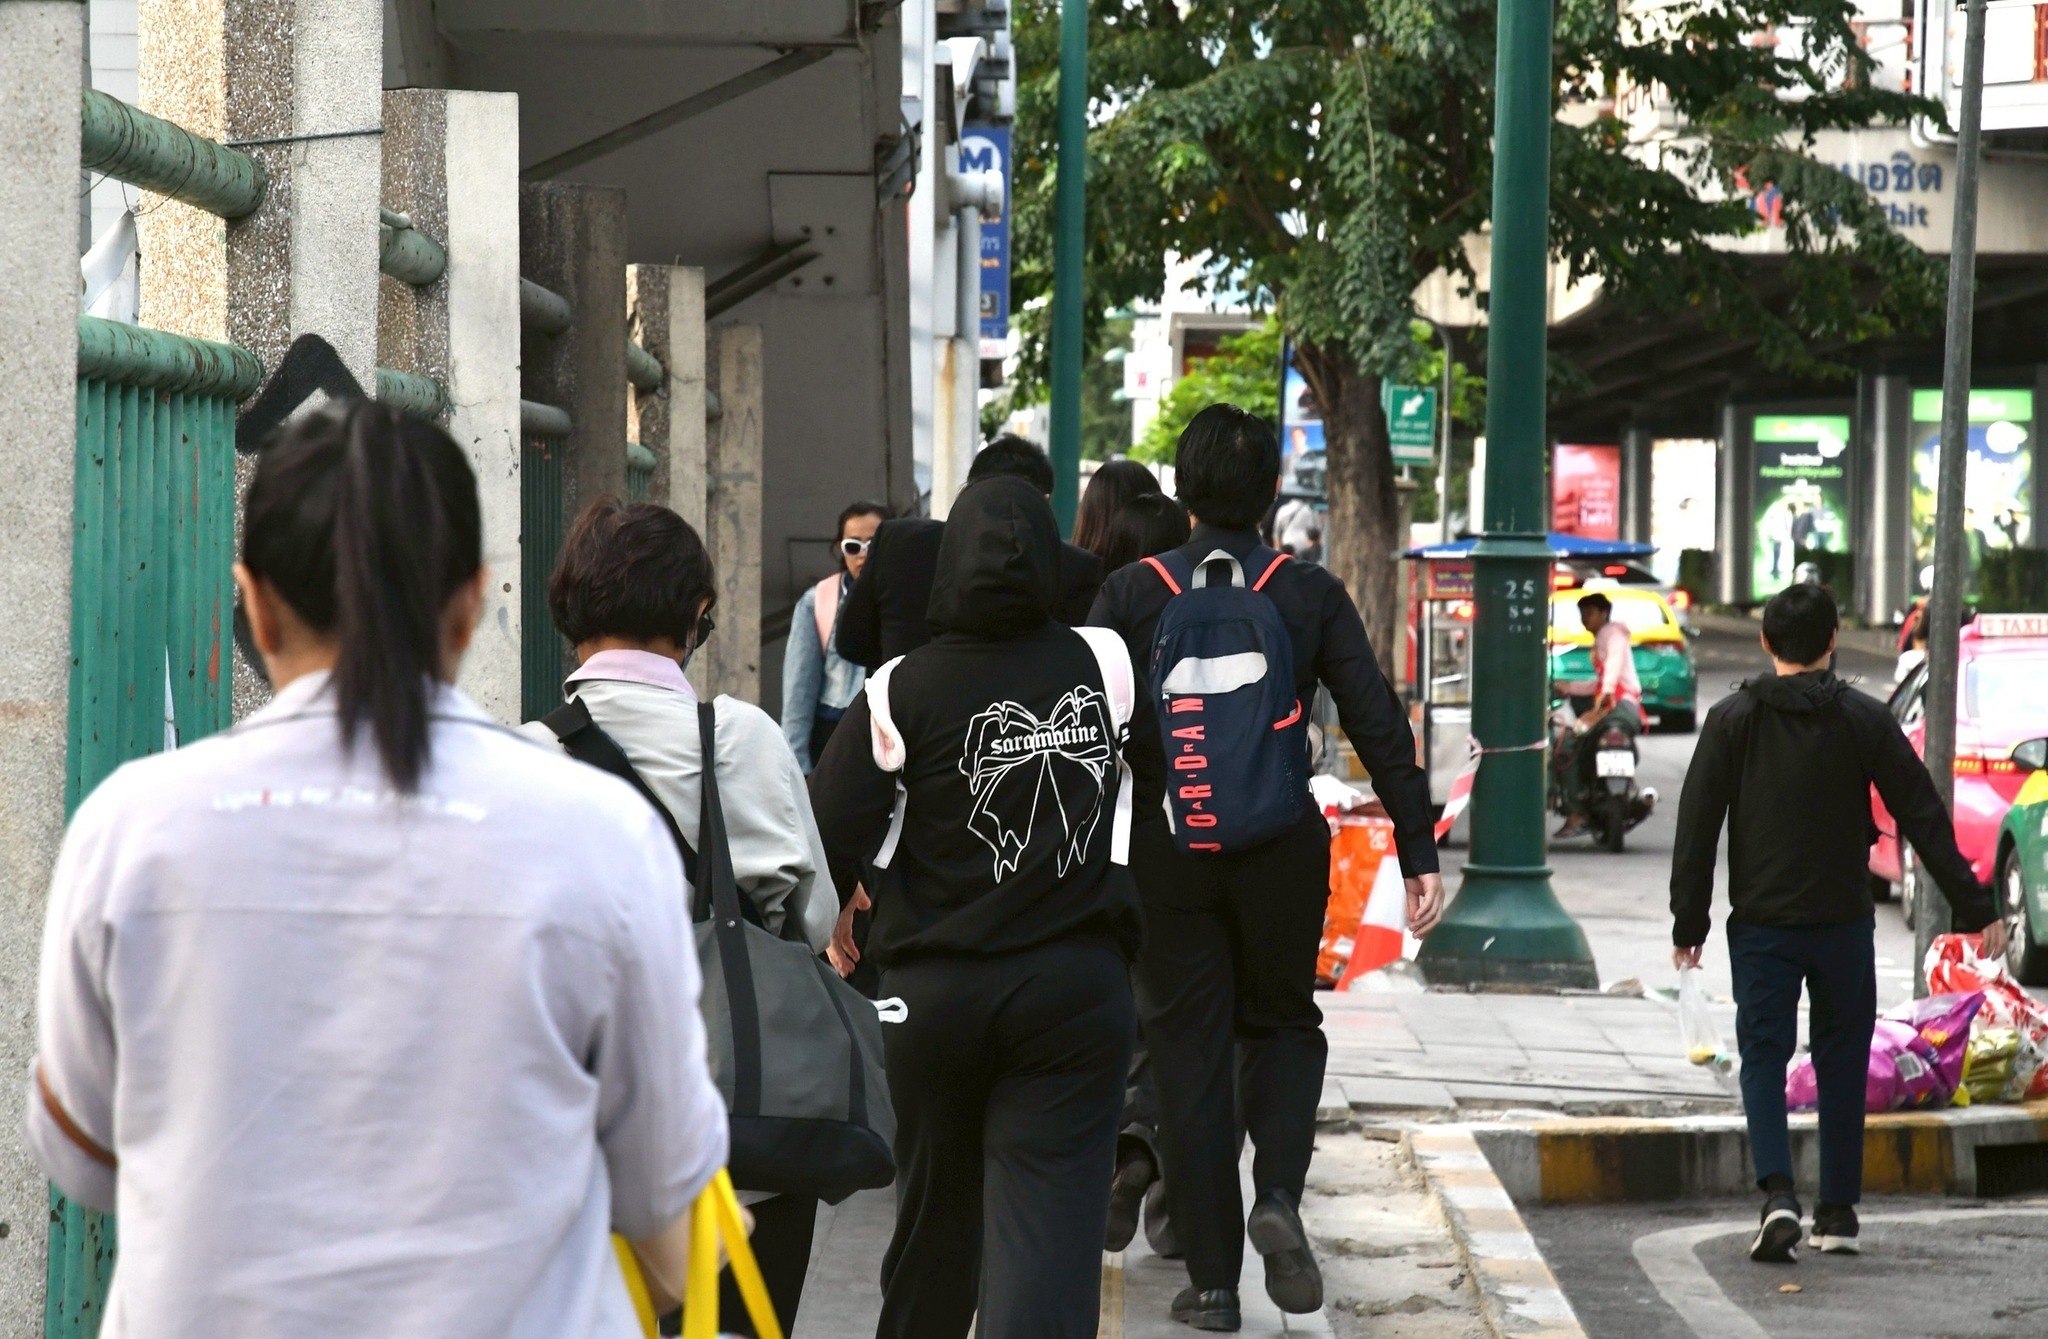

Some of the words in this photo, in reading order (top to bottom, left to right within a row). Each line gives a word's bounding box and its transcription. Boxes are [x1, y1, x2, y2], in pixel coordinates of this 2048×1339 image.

[958, 146, 992, 174] M
[1880, 203, 1929, 227] hit
[990, 723, 1099, 756] saramatine
